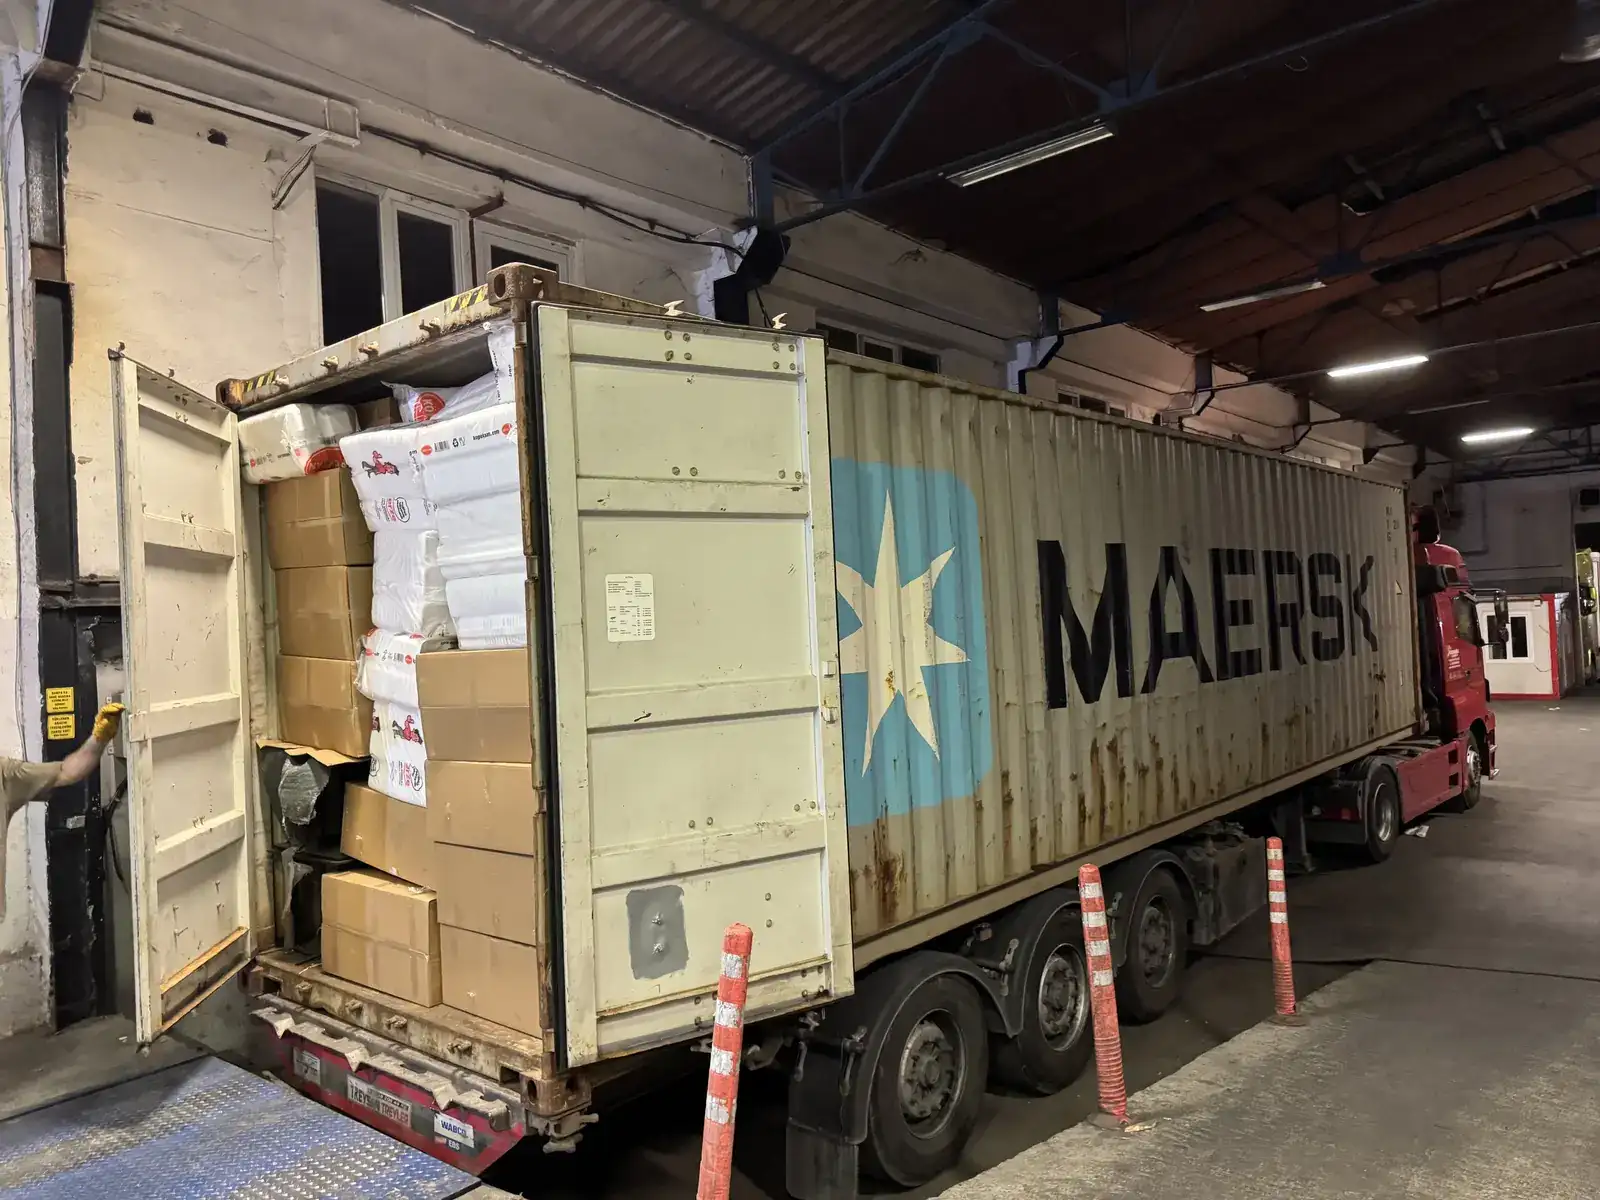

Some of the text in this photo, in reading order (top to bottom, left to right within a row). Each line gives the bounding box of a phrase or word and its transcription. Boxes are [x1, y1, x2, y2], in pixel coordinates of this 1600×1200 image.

[1037, 540, 1378, 709] MAERSK
[440, 1120, 467, 1137] WABCO
[448, 1139, 460, 1151] EBS
